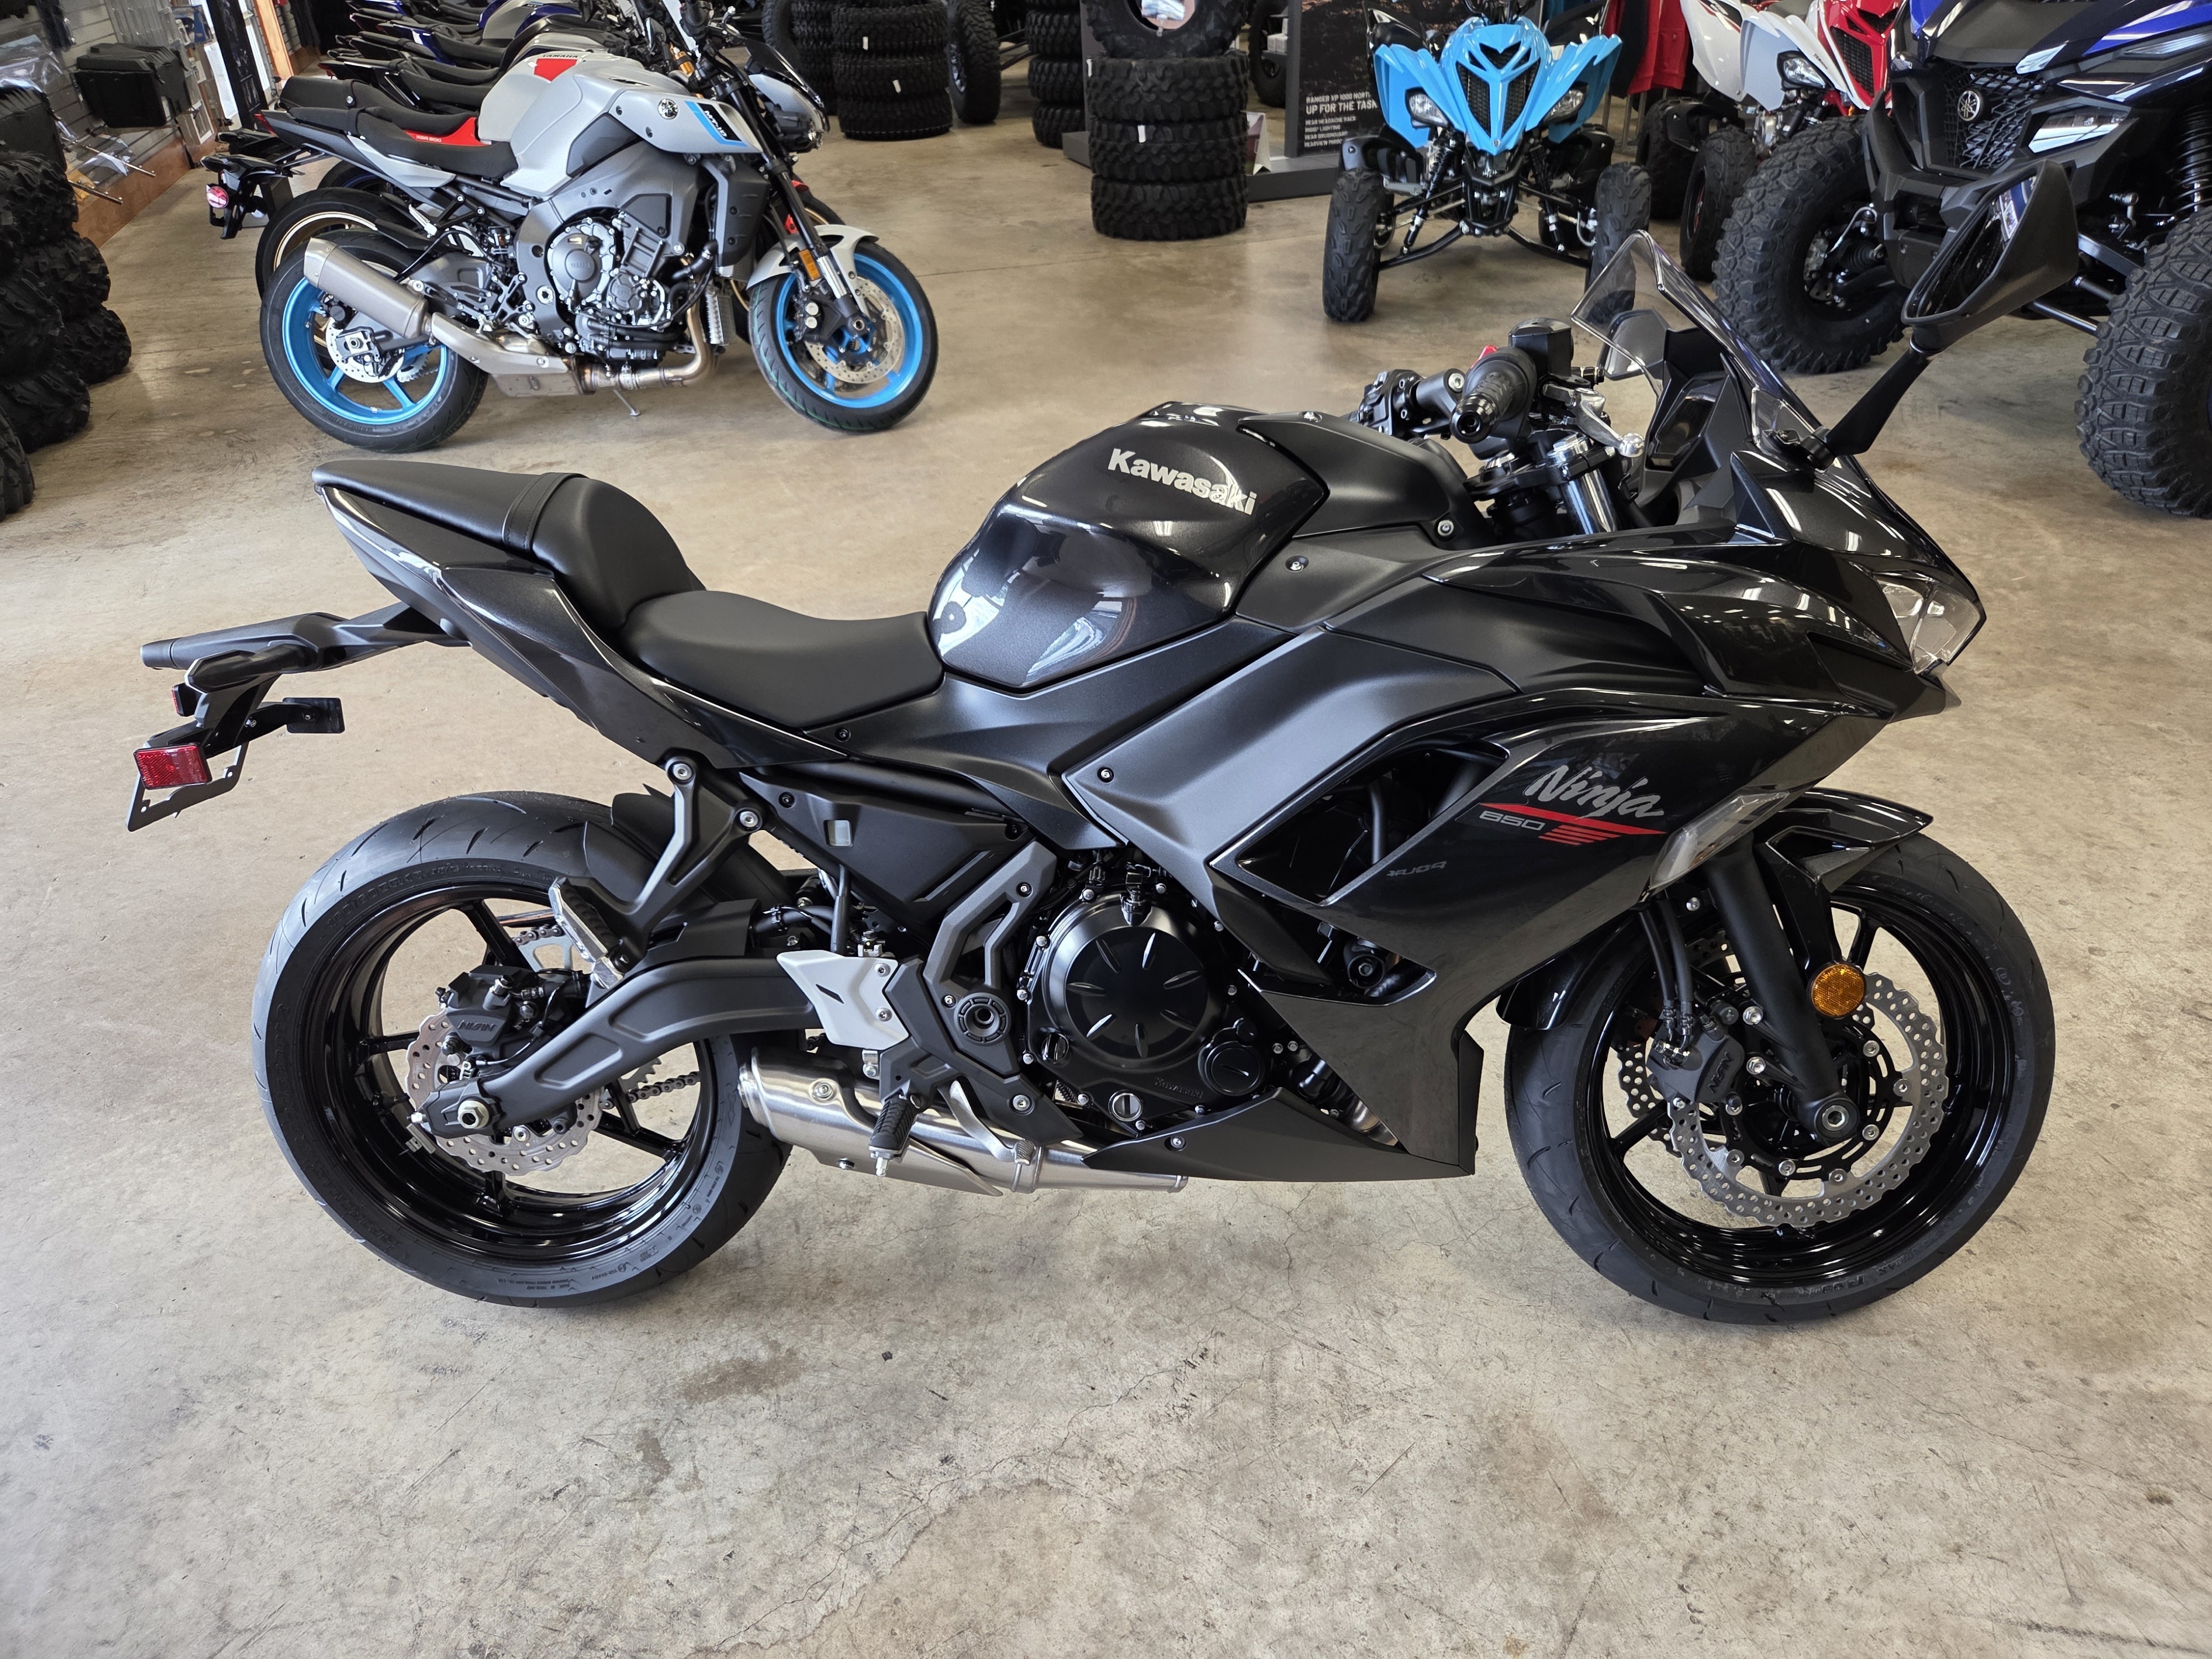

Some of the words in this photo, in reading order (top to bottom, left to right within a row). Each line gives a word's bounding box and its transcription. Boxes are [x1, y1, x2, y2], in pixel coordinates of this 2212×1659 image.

[1306, 95, 1329, 104] RANGER
[1306, 105, 1318, 114] UP
[1319, 103, 1337, 114] FOR
[1338, 101, 1355, 112] THE
[1108, 448, 1258, 515] Kawasaki
[1524, 765, 1665, 820] Ninja
[1479, 810, 1546, 831] 650
